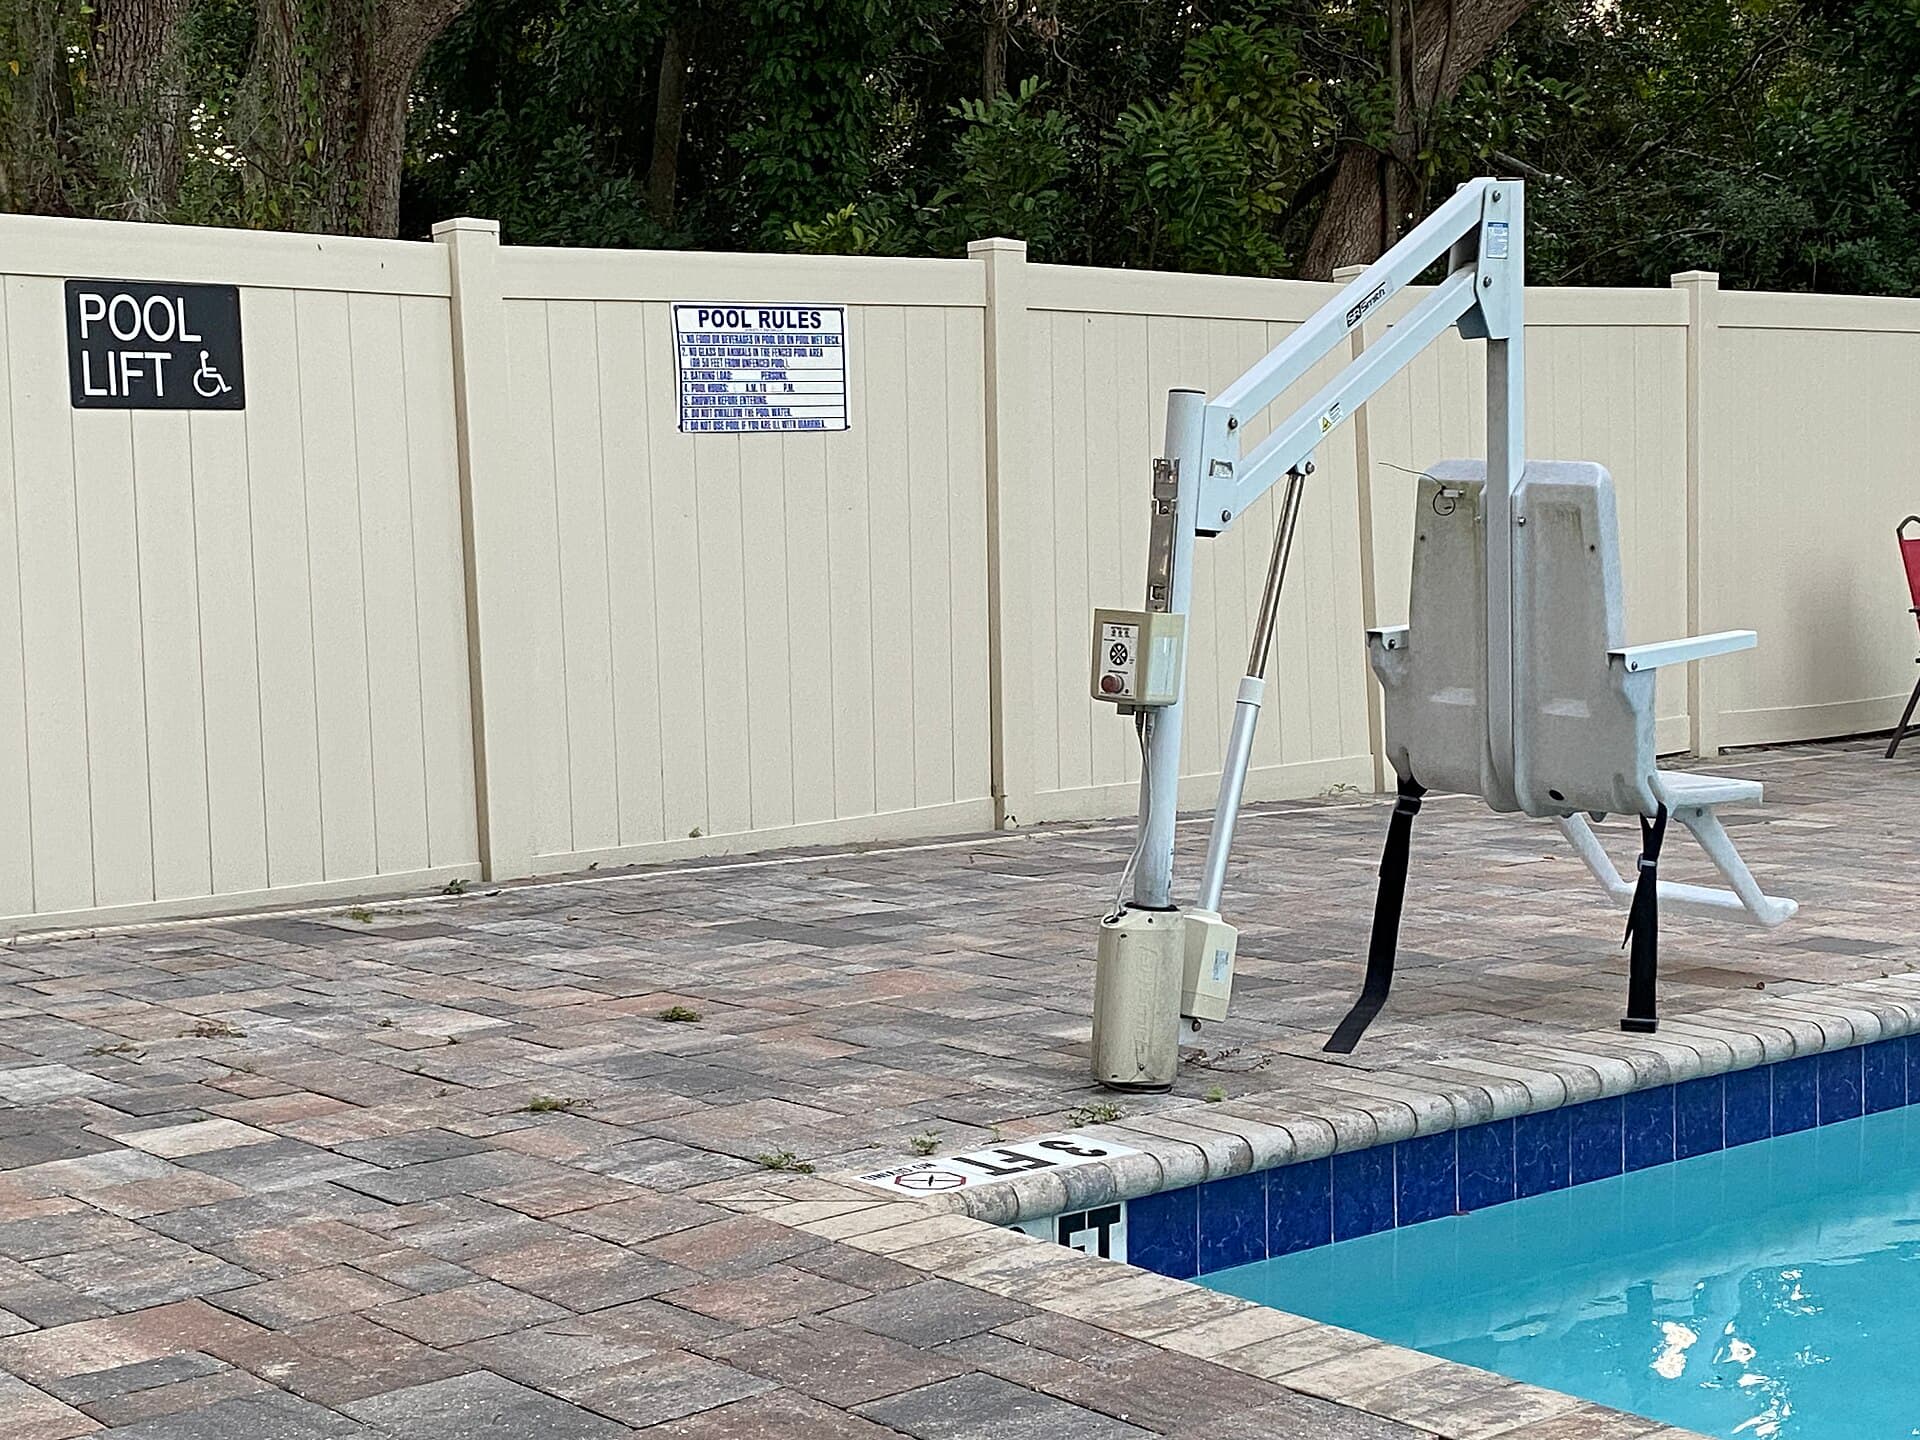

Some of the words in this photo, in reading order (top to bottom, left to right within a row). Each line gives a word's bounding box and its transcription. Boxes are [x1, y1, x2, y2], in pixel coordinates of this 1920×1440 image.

[79, 293, 202, 342] POOL
[698, 310, 752, 328] POOL
[758, 310, 822, 329] RULES
[82, 350, 172, 397] LIFT
[1039, 1140, 1107, 1157] 3
[952, 1149, 1058, 1177] FT
